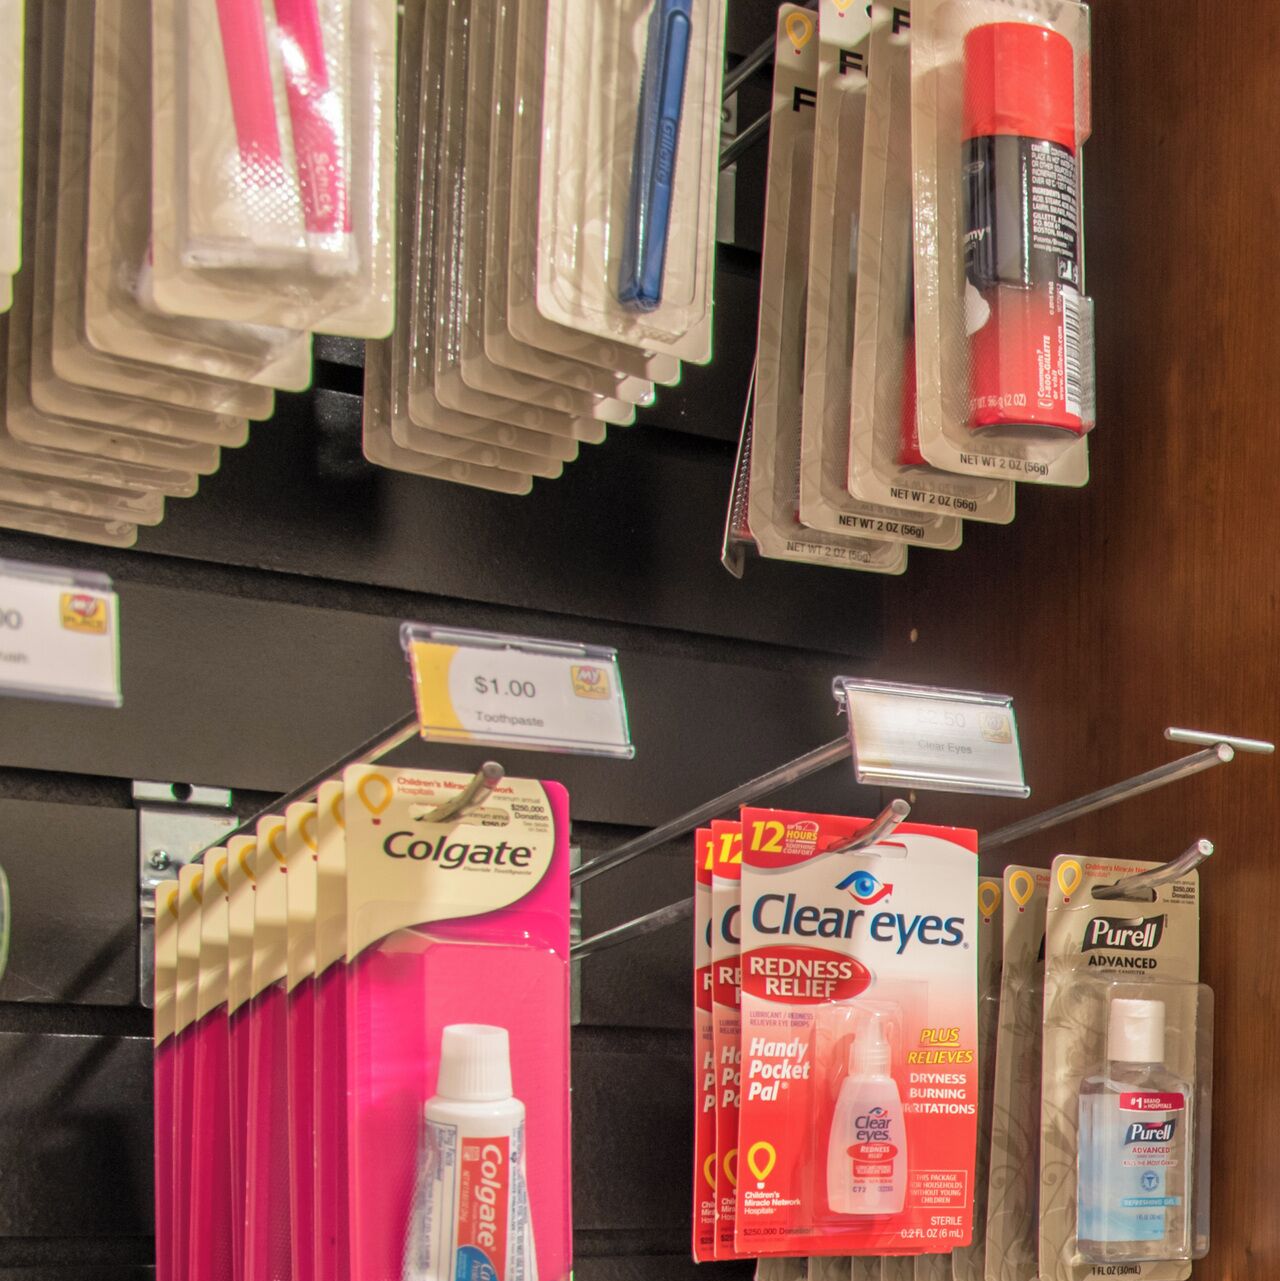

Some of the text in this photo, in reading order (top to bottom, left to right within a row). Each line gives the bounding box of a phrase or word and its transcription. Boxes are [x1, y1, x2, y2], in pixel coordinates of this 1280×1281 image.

[960, 453, 1049, 475] NET WT 2 OZ (56g)
[890, 488, 978, 512] NET WT 2 OZ (56g)
[474, 676, 537, 699] $1.00
[475, 711, 545, 729] Toothpaste
[918, 739, 973, 756] Clear Eyes
[514, 812, 549, 822] Donation
[750, 820, 785, 853] 12
[786, 831, 818, 840] HOURS
[383, 831, 533, 870] Colgate
[752, 893, 965, 955] Clear eyes
[1091, 918, 1157, 948] Purell
[750, 956, 853, 980] REDNESS
[1088, 955, 1158, 970] ADVANCED
[766, 978, 837, 998] RELIEF
[920, 1027, 959, 1044] PLUS
[749, 1037, 808, 1063] Handy
[907, 1050, 973, 1065] RELIEVES
[749, 1058, 810, 1080] Pocket
[910, 1072, 967, 1085] DRYNESS
[748, 1080, 780, 1101] Pal
[909, 1087, 966, 1100] BURNING
[1130, 1097, 1143, 1109] #1
[855, 1116, 892, 1129] Clear
[1130, 1123, 1172, 1141] Purell
[860, 1145, 890, 1153] REDNESS
[474, 1144, 503, 1248] Colgate
[931, 1216, 963, 1226] STERILE
[1092, 1264, 1141, 1276] 1 FL OZ (30mL)
